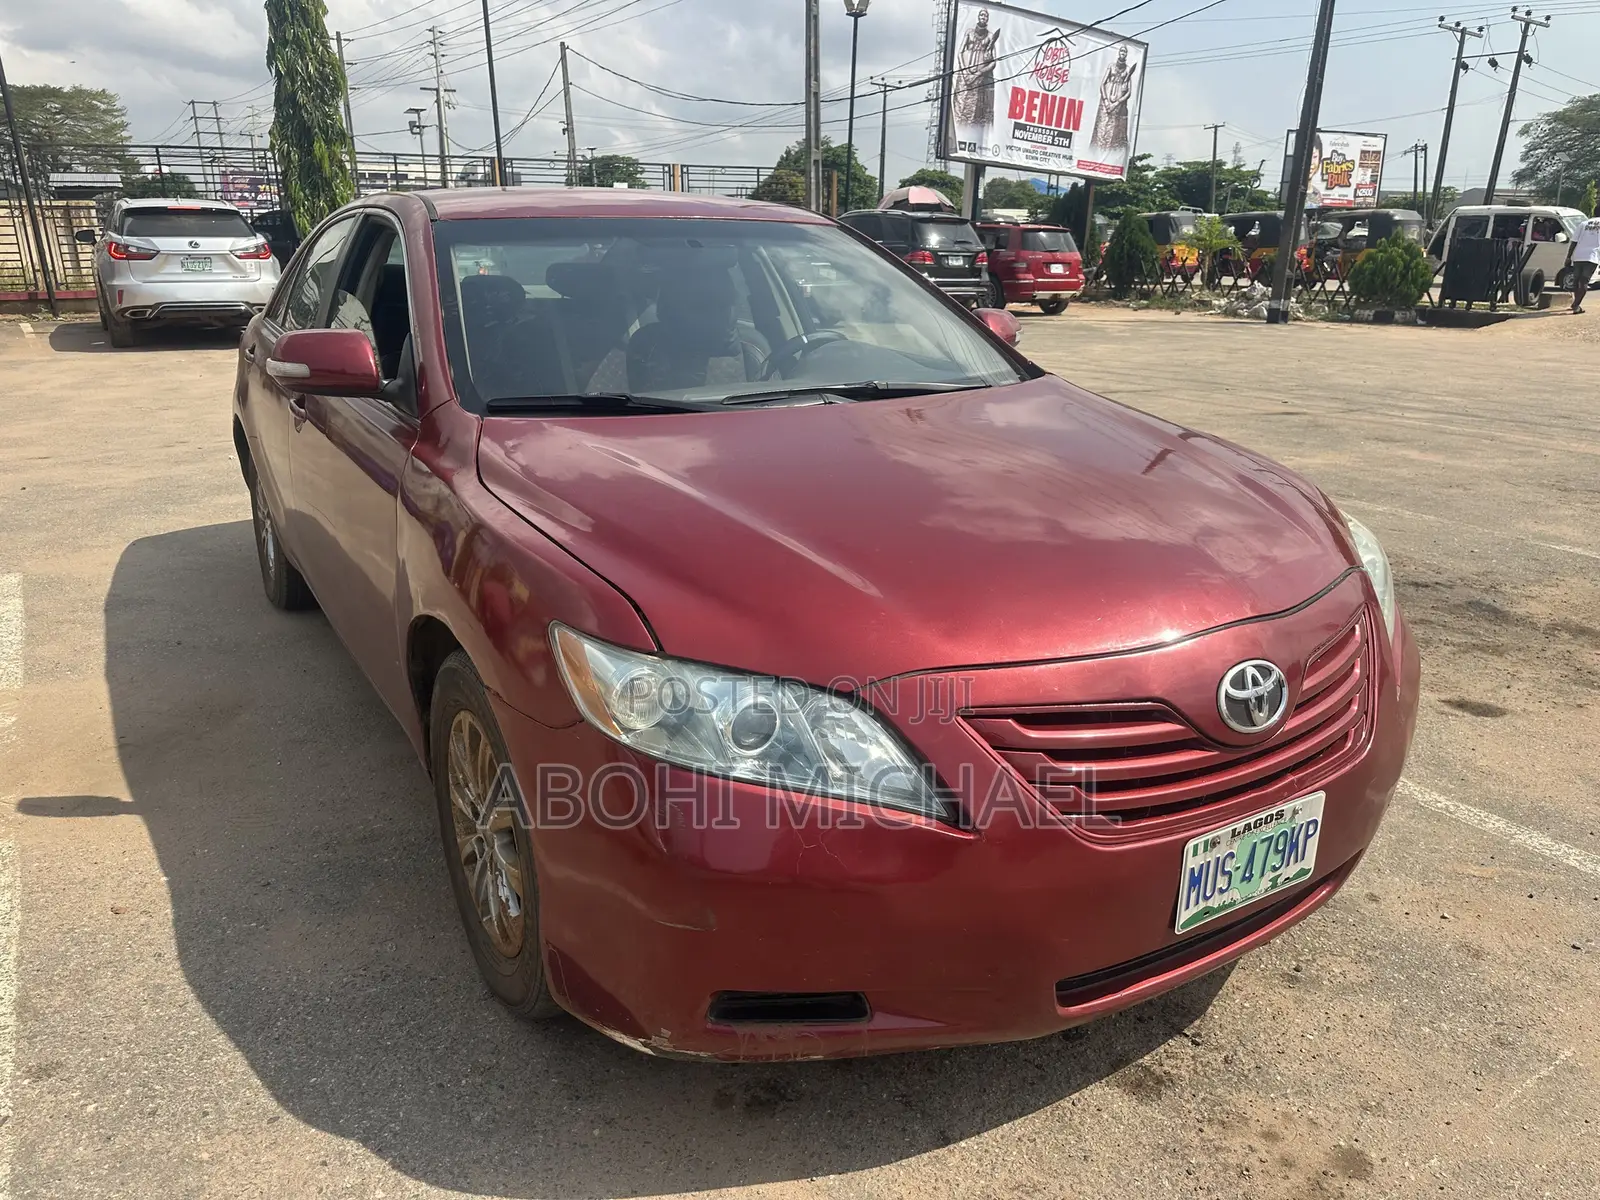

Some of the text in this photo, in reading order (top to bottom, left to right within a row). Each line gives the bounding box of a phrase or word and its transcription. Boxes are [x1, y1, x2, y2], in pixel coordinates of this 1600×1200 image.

[1029, 61, 1069, 83] HOUSE
[1008, 86, 1084, 131] BENIN
[1013, 128, 1070, 148] NOVEMBER 5TH
[1026, 125, 1058, 137] THURSDAY
[1005, 144, 1022, 152] VICTOR
[1039, 150, 1062, 160] CREATIVE
[1331, 152, 1345, 165] Buy
[1323, 160, 1354, 174] Fabrics
[1327, 171, 1350, 188] Bulk
[1230, 808, 1285, 839] LAGOS
